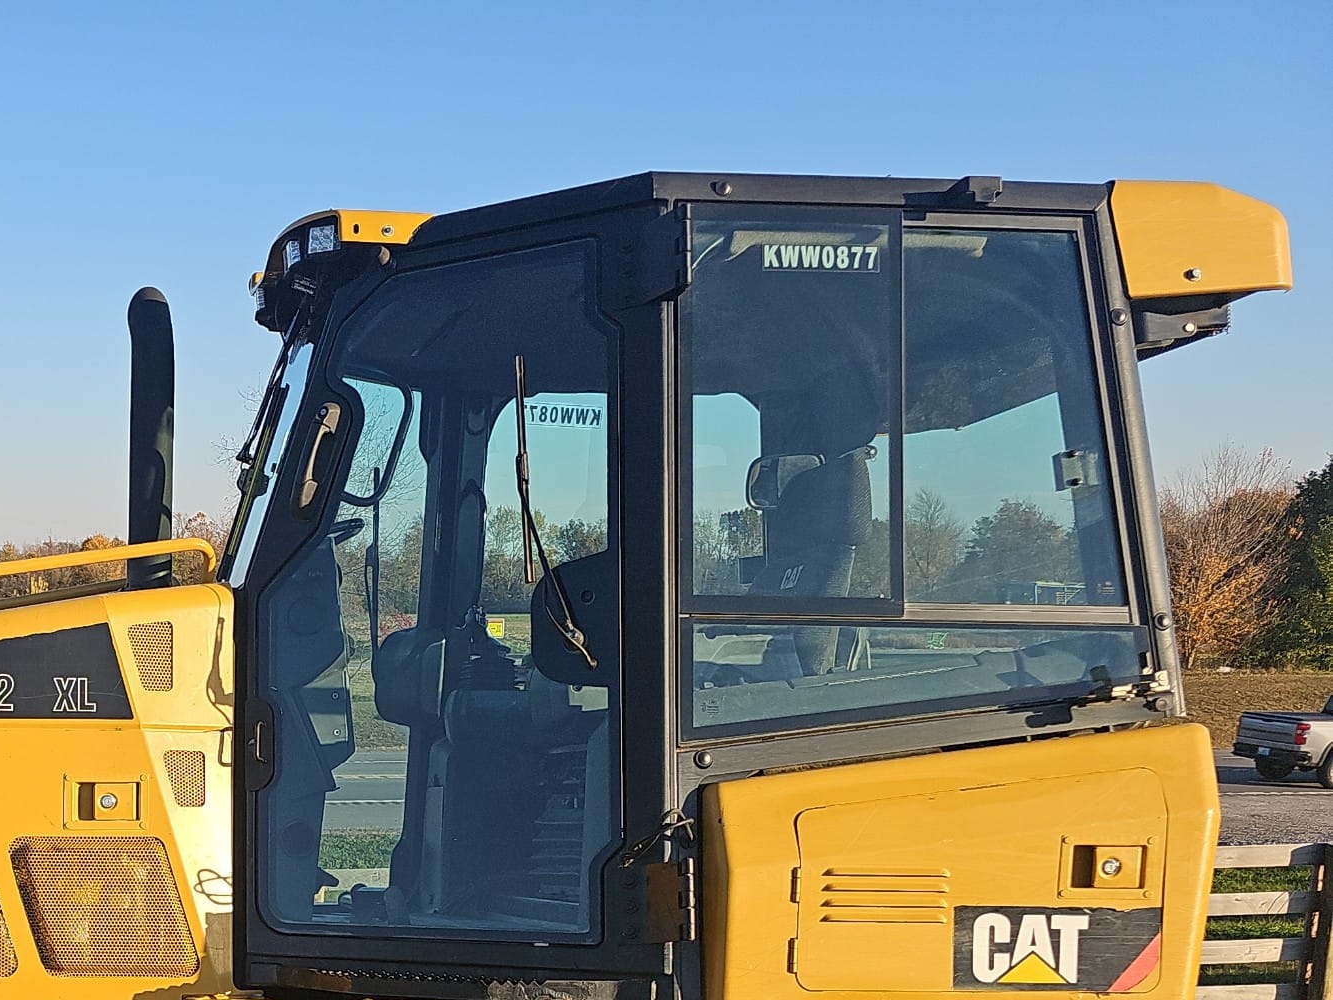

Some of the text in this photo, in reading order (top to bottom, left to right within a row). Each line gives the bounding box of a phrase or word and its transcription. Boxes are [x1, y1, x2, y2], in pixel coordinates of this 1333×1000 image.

[763, 244, 878, 270] KWW0877
[780, 565, 804, 590] CAT
[53, 677, 97, 713] XL
[972, 912, 1090, 984] CAT
